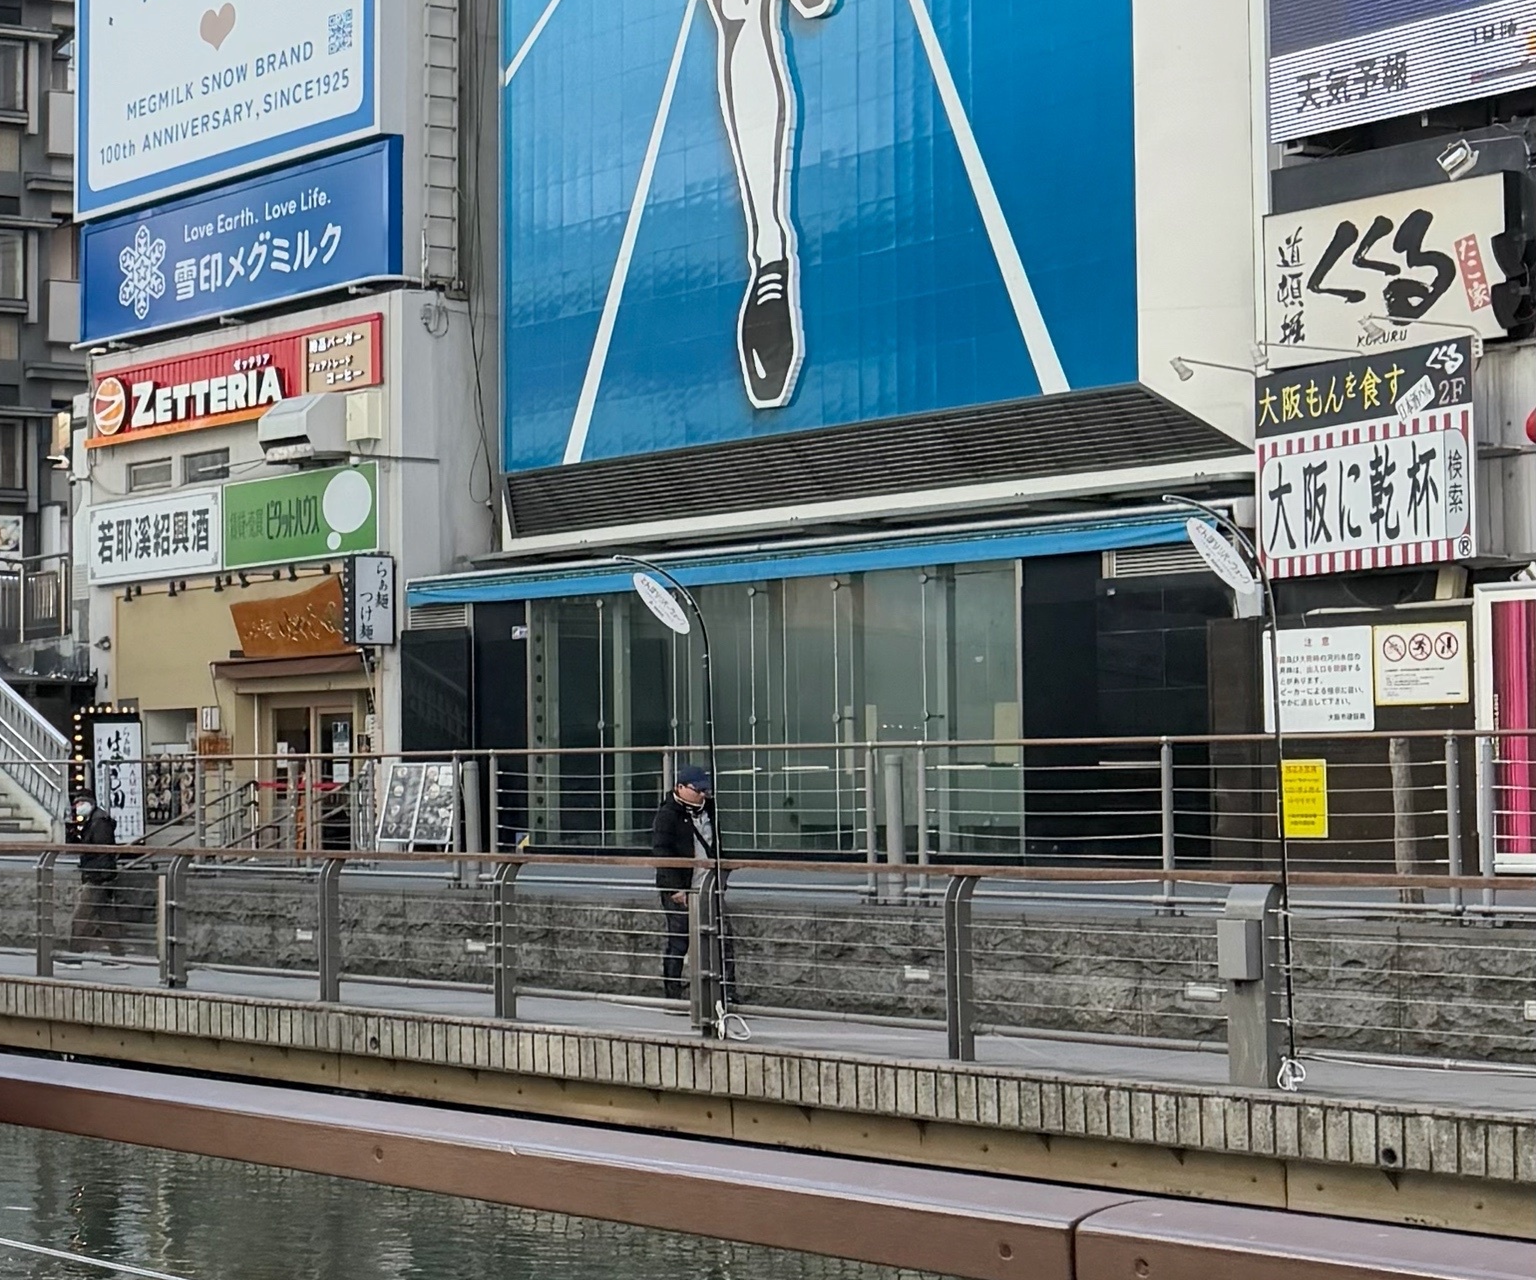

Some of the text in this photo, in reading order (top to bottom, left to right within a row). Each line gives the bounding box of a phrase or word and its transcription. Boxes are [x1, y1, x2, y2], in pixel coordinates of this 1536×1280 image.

[126, 40, 314, 121] MEGMILK SNOW BRAND
[99, 136, 136, 166] 100th
[184, 187, 332, 243] Love Earth. Love Life.
[173, 221, 343, 302] 雪印メグミルク
[1276, 226, 1306, 344] 道頓堀
[1306, 208, 1457, 326] くくる
[233, 353, 271, 371] ゼッテリア
[326, 369, 365, 385] コーヒー
[1426, 343, 1464, 375] くくる
[131, 365, 284, 428] ZETTERIA
[1258, 363, 1406, 427] 大阪もんを食す
[1438, 376, 1467, 406] 2F
[1268, 440, 1440, 554] 大阪に乾杯
[1447, 448, 1465, 515] 検索
[375, 561, 389, 609] らぁ麺
[360, 591, 374, 641] つけ麺
